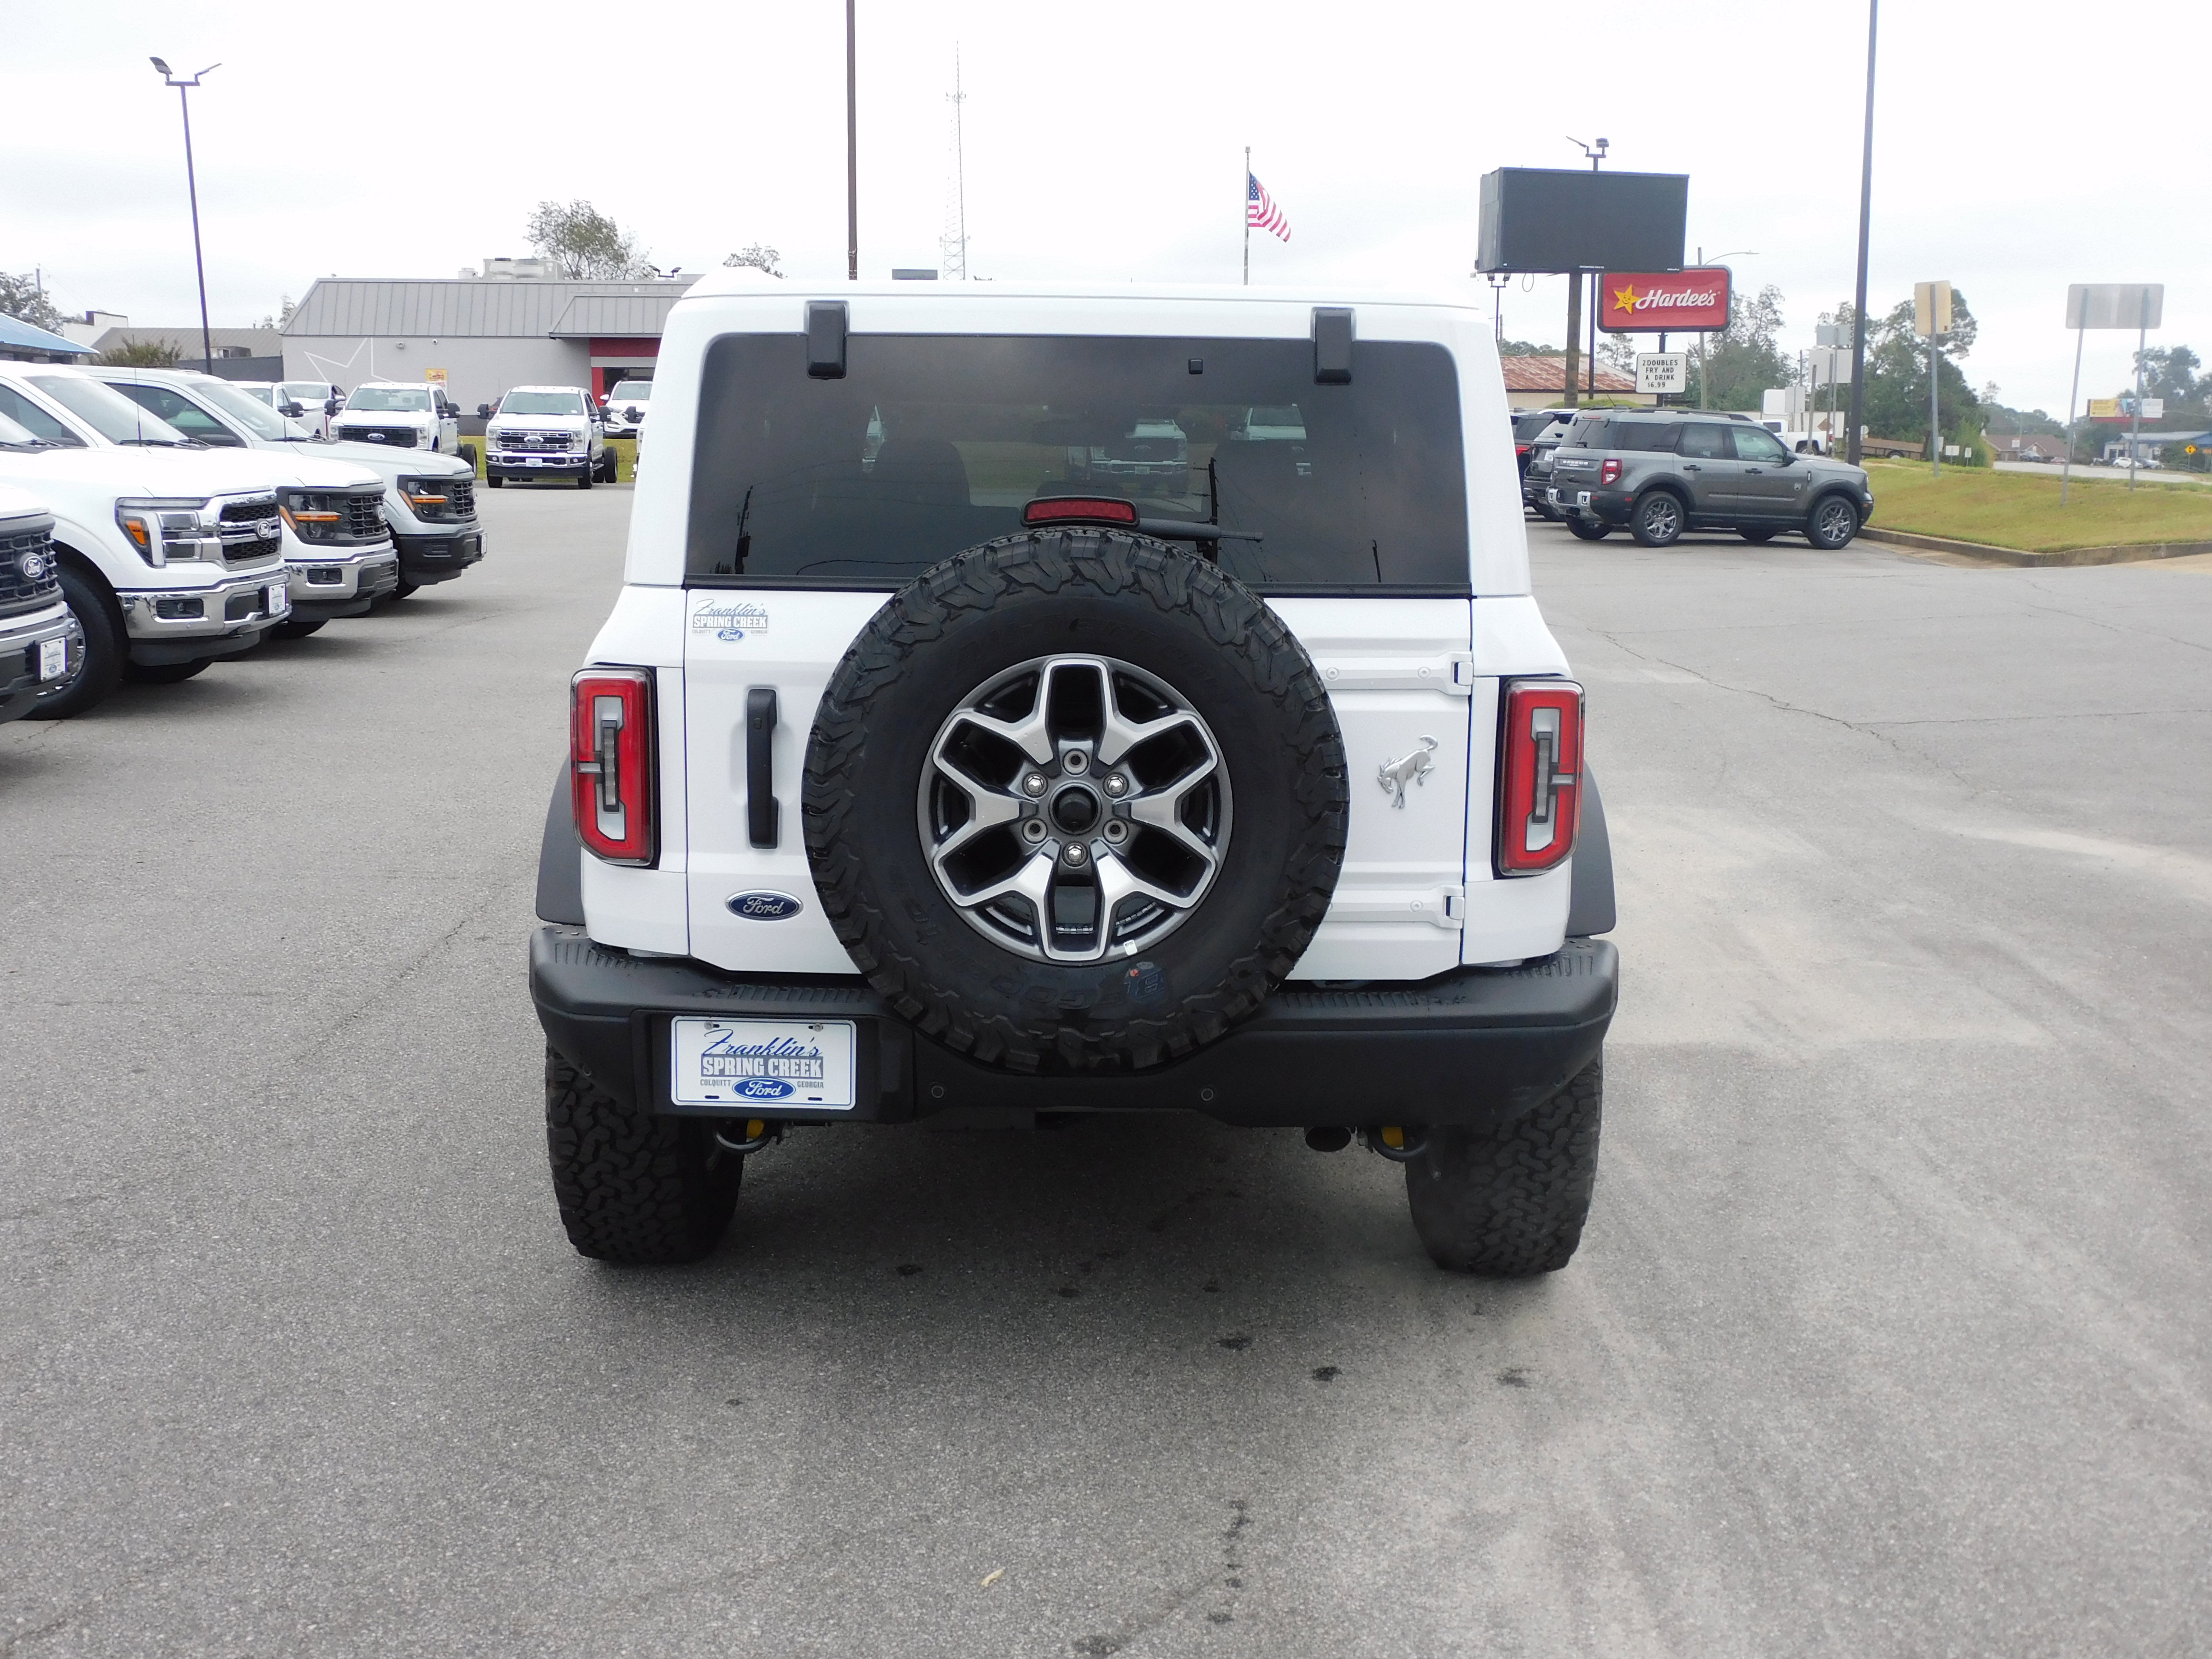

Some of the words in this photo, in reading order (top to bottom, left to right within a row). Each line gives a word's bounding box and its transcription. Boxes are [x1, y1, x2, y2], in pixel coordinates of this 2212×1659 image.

[1635, 289, 1717, 309] Hardee's
[695, 599, 766, 615] Franklin's
[693, 615, 732, 628] SPRING
[733, 616, 768, 628] CREEK
[721, 629, 740, 640] Ford
[743, 896, 785, 914] Ford
[701, 1028, 823, 1057] Franklin's
[702, 1057, 765, 1077] SPRING
[768, 1058, 822, 1078] CREEK
[700, 1079, 732, 1087] COLQUITT
[745, 1080, 783, 1097] Ford
[796, 1080, 824, 1089] GEORGIA
